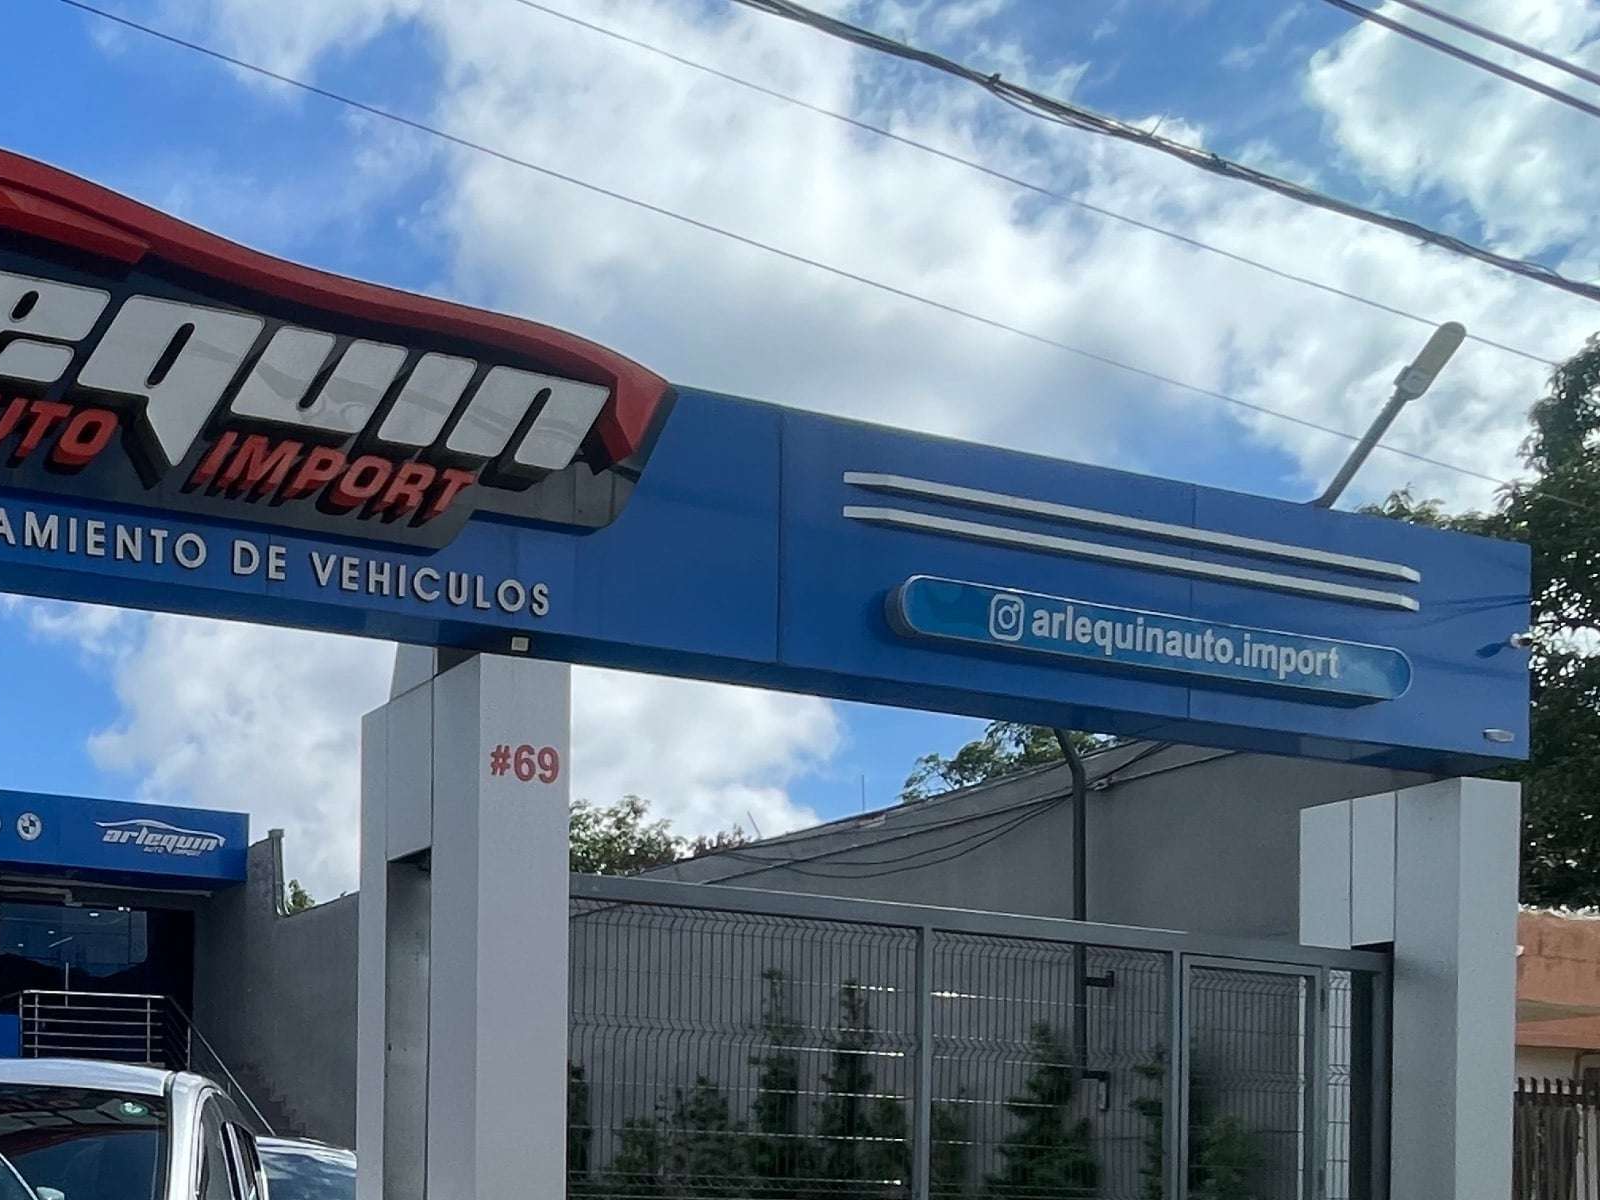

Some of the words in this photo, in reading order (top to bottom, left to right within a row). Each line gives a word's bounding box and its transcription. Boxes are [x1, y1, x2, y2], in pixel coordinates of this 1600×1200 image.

[194, 430, 476, 516] IMPORT
[232, 539, 288, 581] DE
[310, 551, 551, 617] VEHICULOS
[1031, 605, 1341, 680] arlequinauto.import
[490, 744, 560, 784] #69
[102, 826, 218, 853] arlequin
